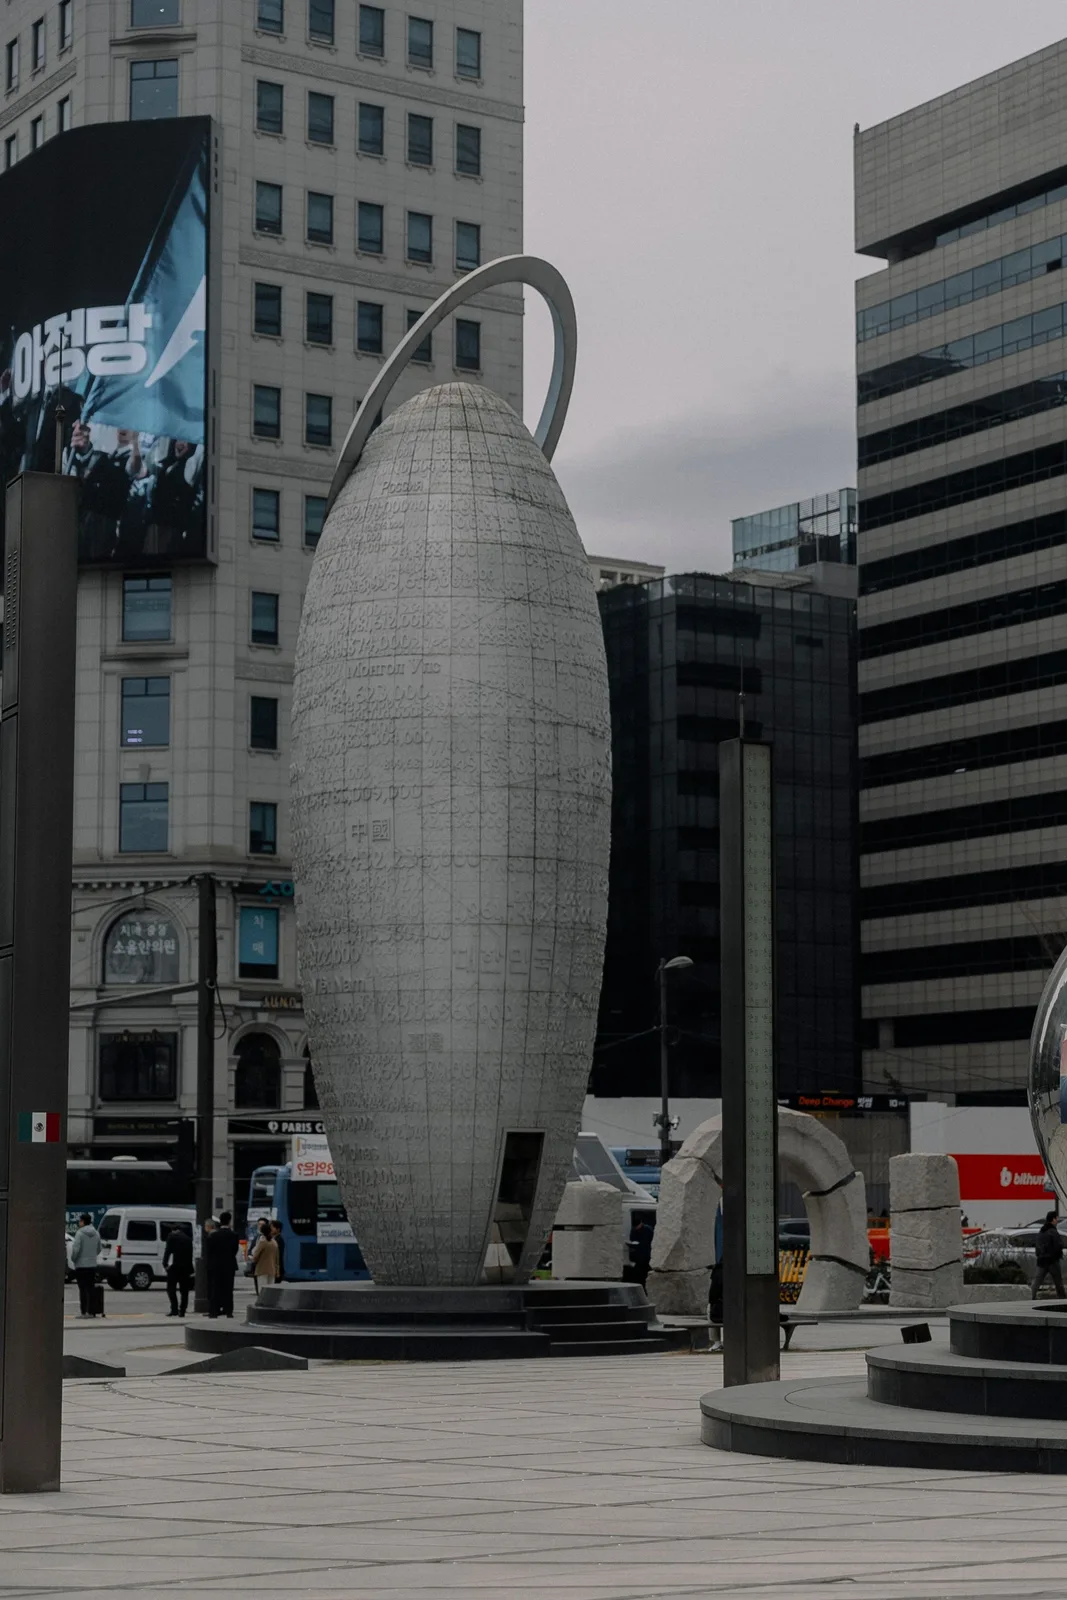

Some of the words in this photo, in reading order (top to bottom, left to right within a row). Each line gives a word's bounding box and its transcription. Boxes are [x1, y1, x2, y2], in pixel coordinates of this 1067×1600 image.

[13, 303, 154, 399] 아정당
[798, 1095, 821, 1108] Deep
[822, 1096, 855, 1108] Change
[281, 1122, 312, 1133] PARIS
[1014, 1172, 1046, 1186] bithum
